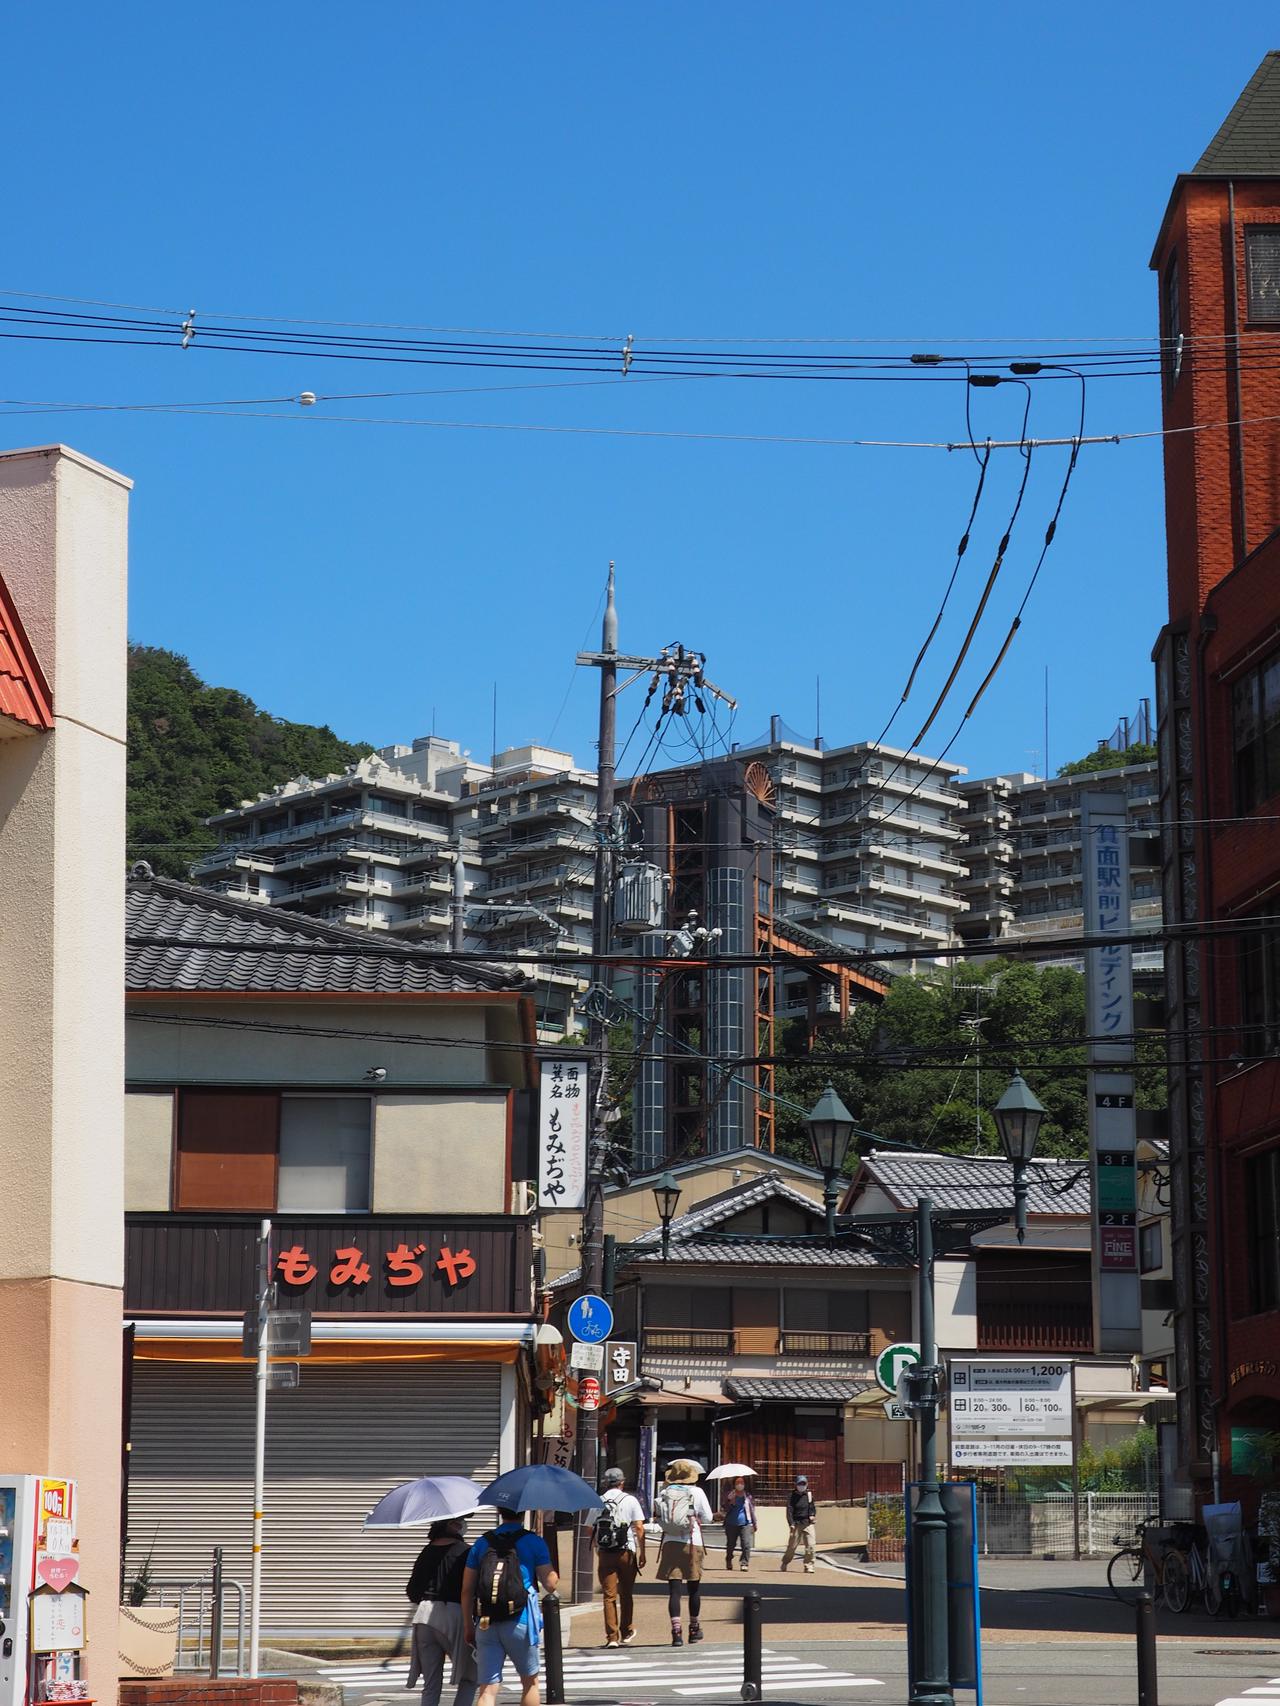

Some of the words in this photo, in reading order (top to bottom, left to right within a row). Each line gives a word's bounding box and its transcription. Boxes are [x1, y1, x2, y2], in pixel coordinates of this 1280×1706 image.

[1097, 823, 1122, 1032] 箕面駅前ビルディング
[542, 1107, 566, 1206] もみぢや
[277, 1243, 477, 1287] もみぢや
[612, 1346, 632, 1383] 守田
